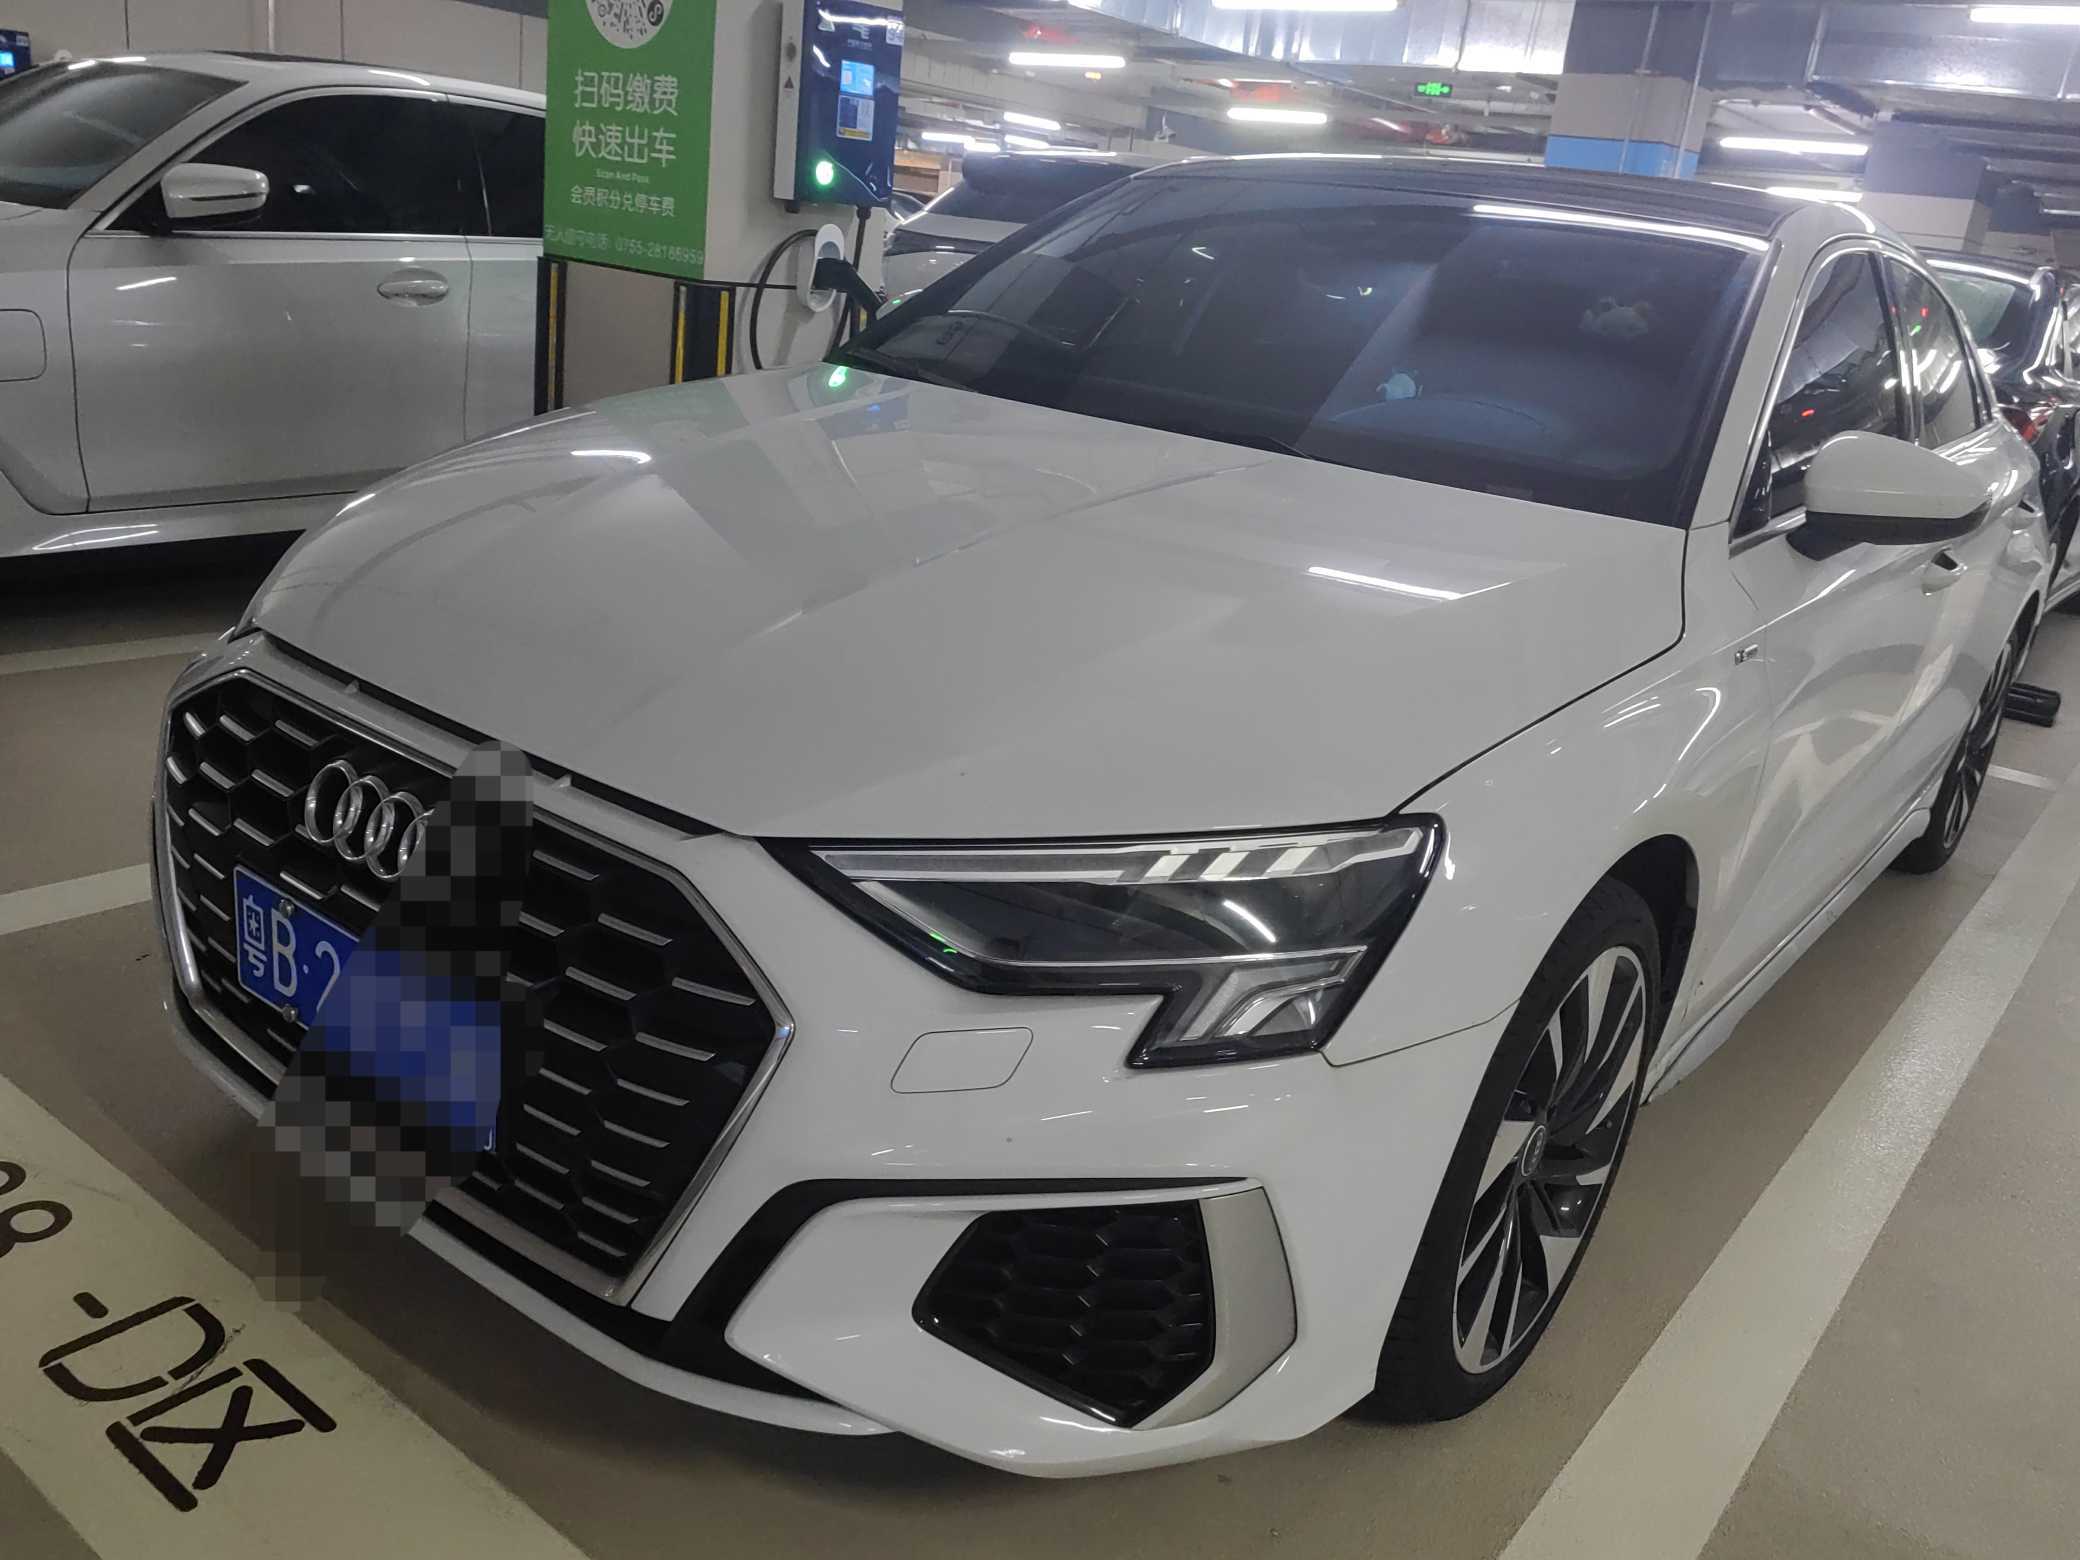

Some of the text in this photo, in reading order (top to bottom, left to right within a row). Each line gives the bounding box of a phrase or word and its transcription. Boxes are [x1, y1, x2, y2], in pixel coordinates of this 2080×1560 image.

[574, 69, 679, 116] 扫码缴费
[572, 120, 677, 168] 快速出车
[570, 185, 675, 217] 会员积分兑停车费
